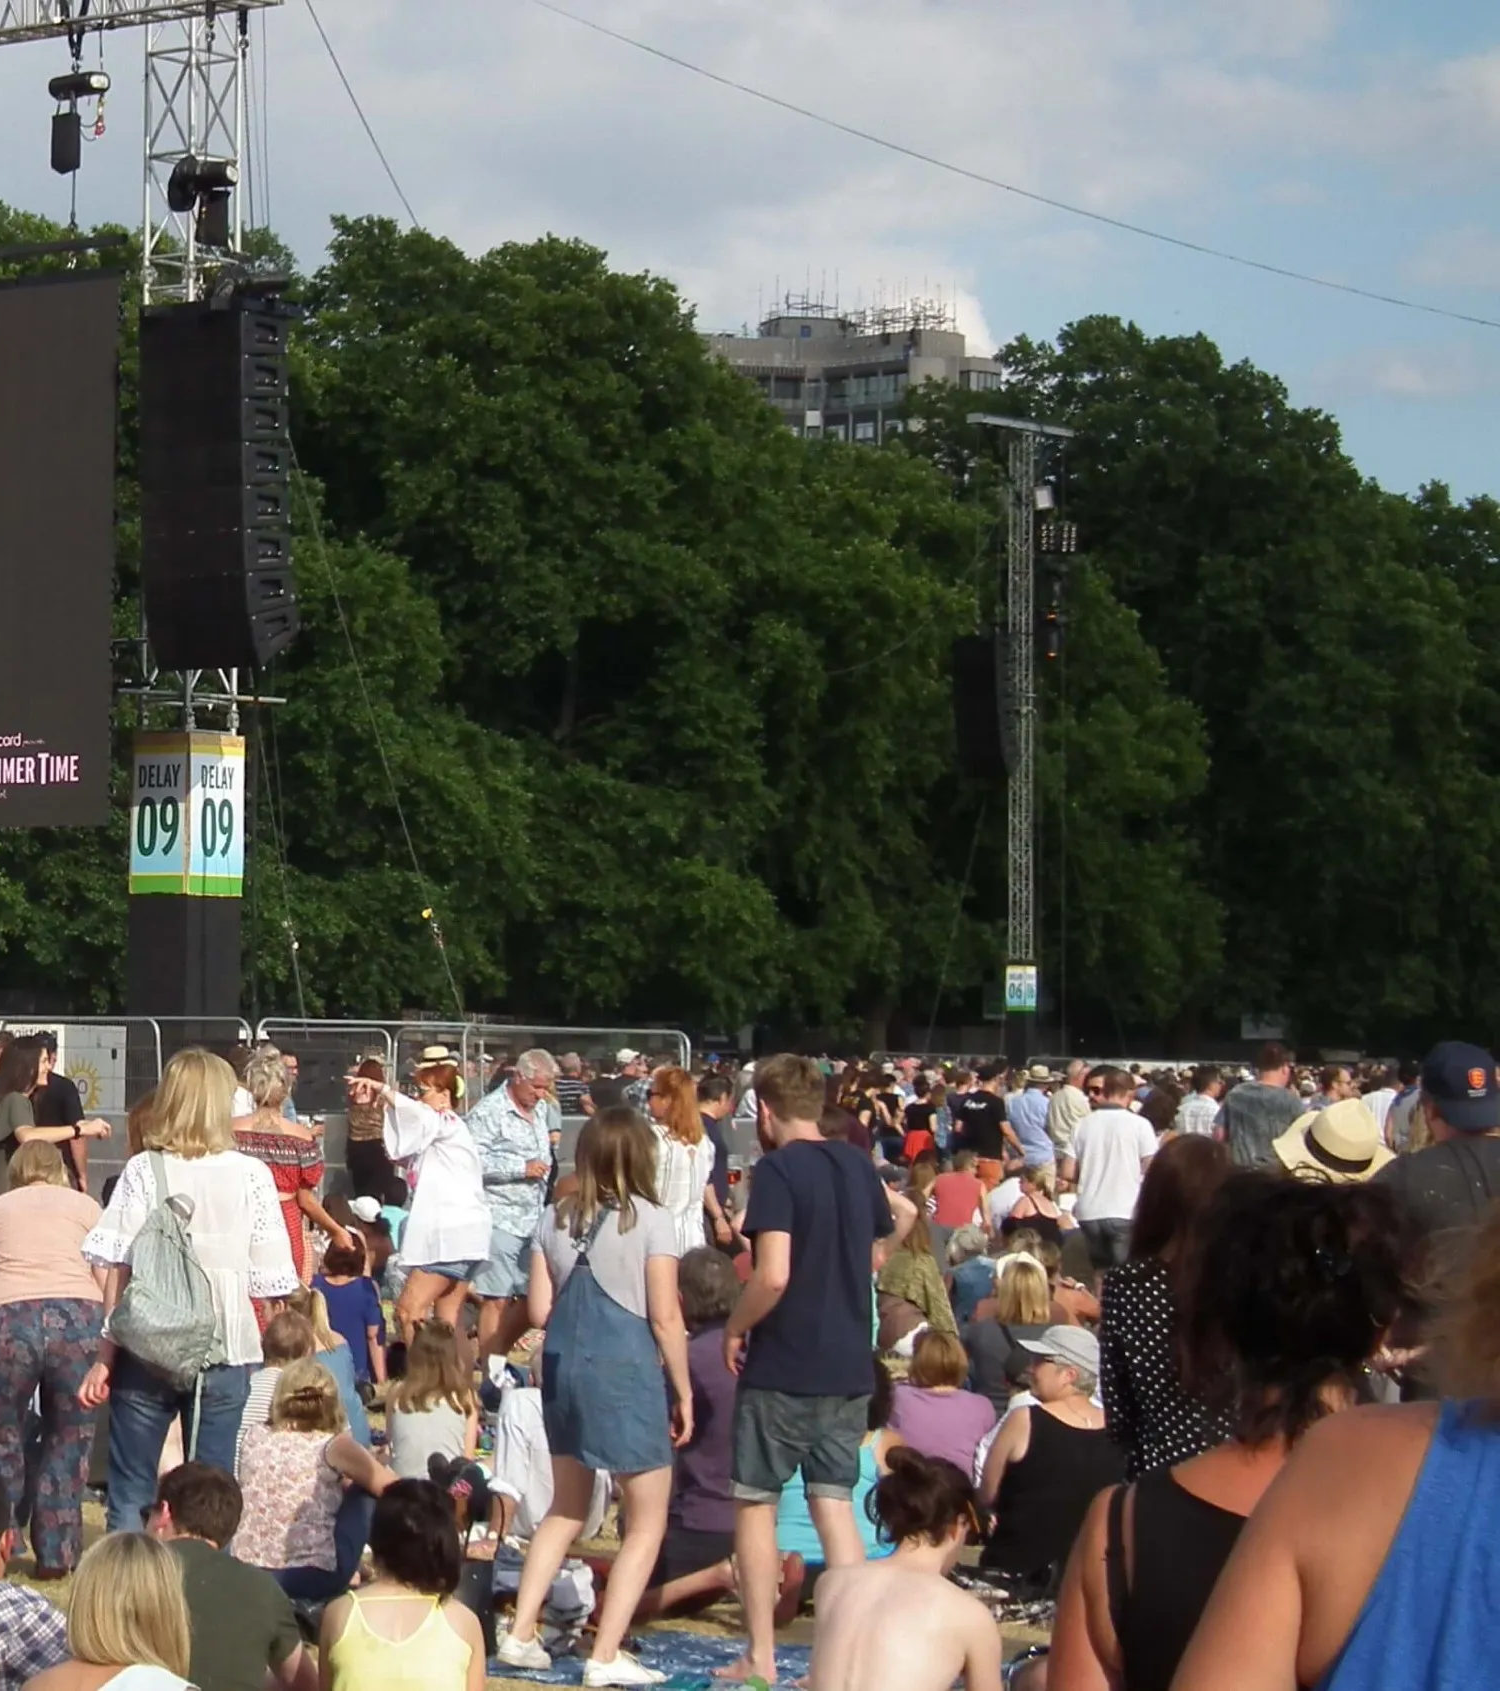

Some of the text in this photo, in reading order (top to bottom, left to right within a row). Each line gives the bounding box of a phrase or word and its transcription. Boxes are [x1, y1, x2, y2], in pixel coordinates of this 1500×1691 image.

[38, 753, 79, 785] TIME
[138, 764, 181, 789] DELAY
[201, 764, 235, 790] DELAY
[137, 796, 180, 857] 09
[201, 797, 234, 858] 09
[1008, 983, 1022, 999] 06
